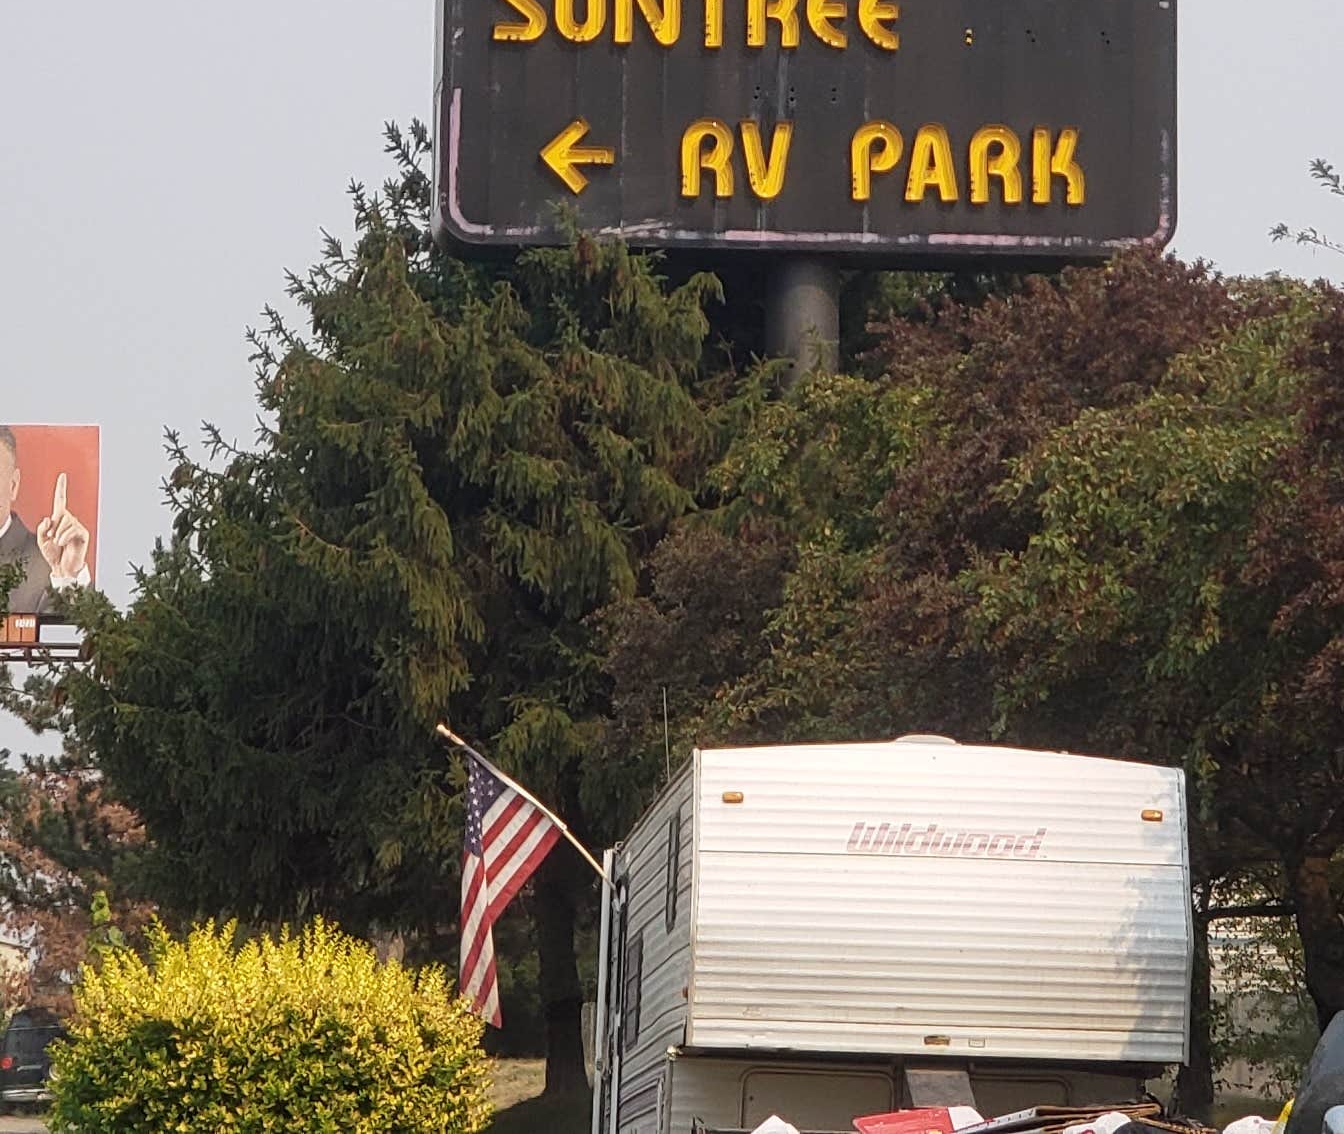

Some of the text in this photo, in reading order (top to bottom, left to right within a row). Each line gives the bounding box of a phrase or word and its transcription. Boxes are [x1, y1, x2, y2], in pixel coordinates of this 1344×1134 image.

[679, 117, 1087, 207] RV PARK
[847, 821, 1046, 857] Wildwood
